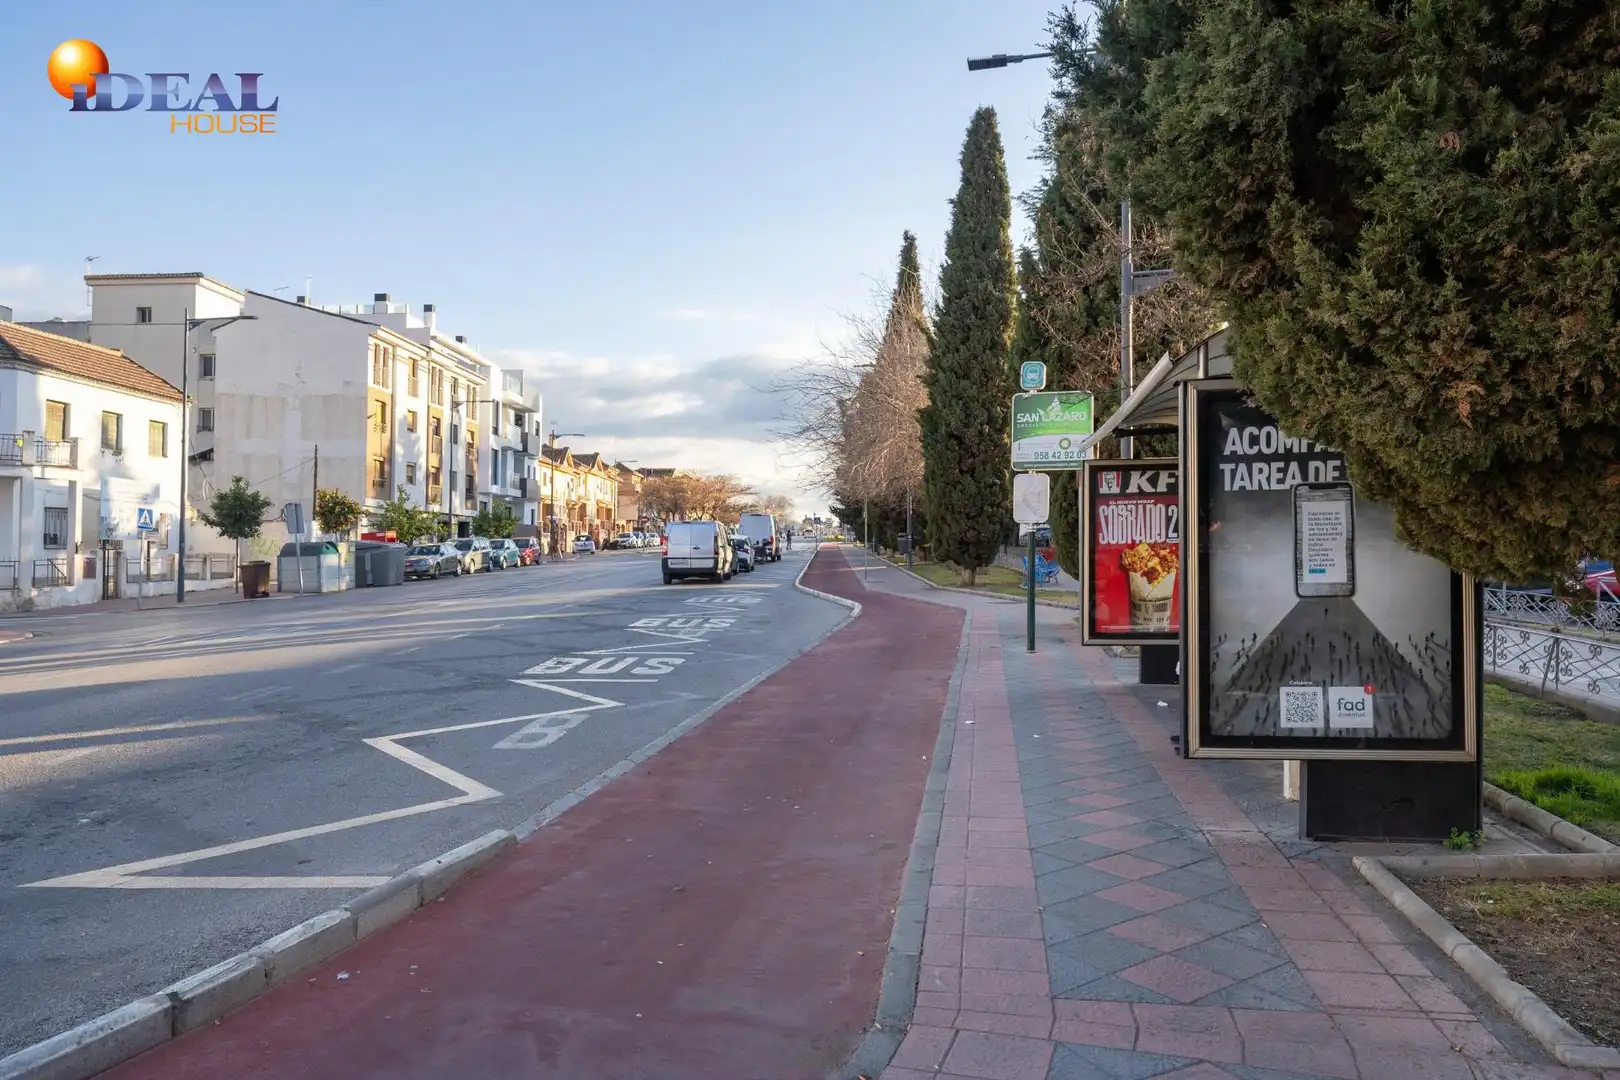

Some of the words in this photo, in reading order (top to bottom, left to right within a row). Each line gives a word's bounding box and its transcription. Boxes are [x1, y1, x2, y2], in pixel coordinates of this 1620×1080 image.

[1016, 412, 1040, 423] SAN
[1033, 451, 1049, 460] 958
[1051, 451, 1062, 460] 42
[1064, 450, 1075, 460] 92
[1076, 450, 1087, 459] 03
[1219, 461, 1303, 491] TAREA
[627, 617, 737, 629] BUS
[520, 656, 686, 675] BUS
[1337, 697, 1366, 712] fad
